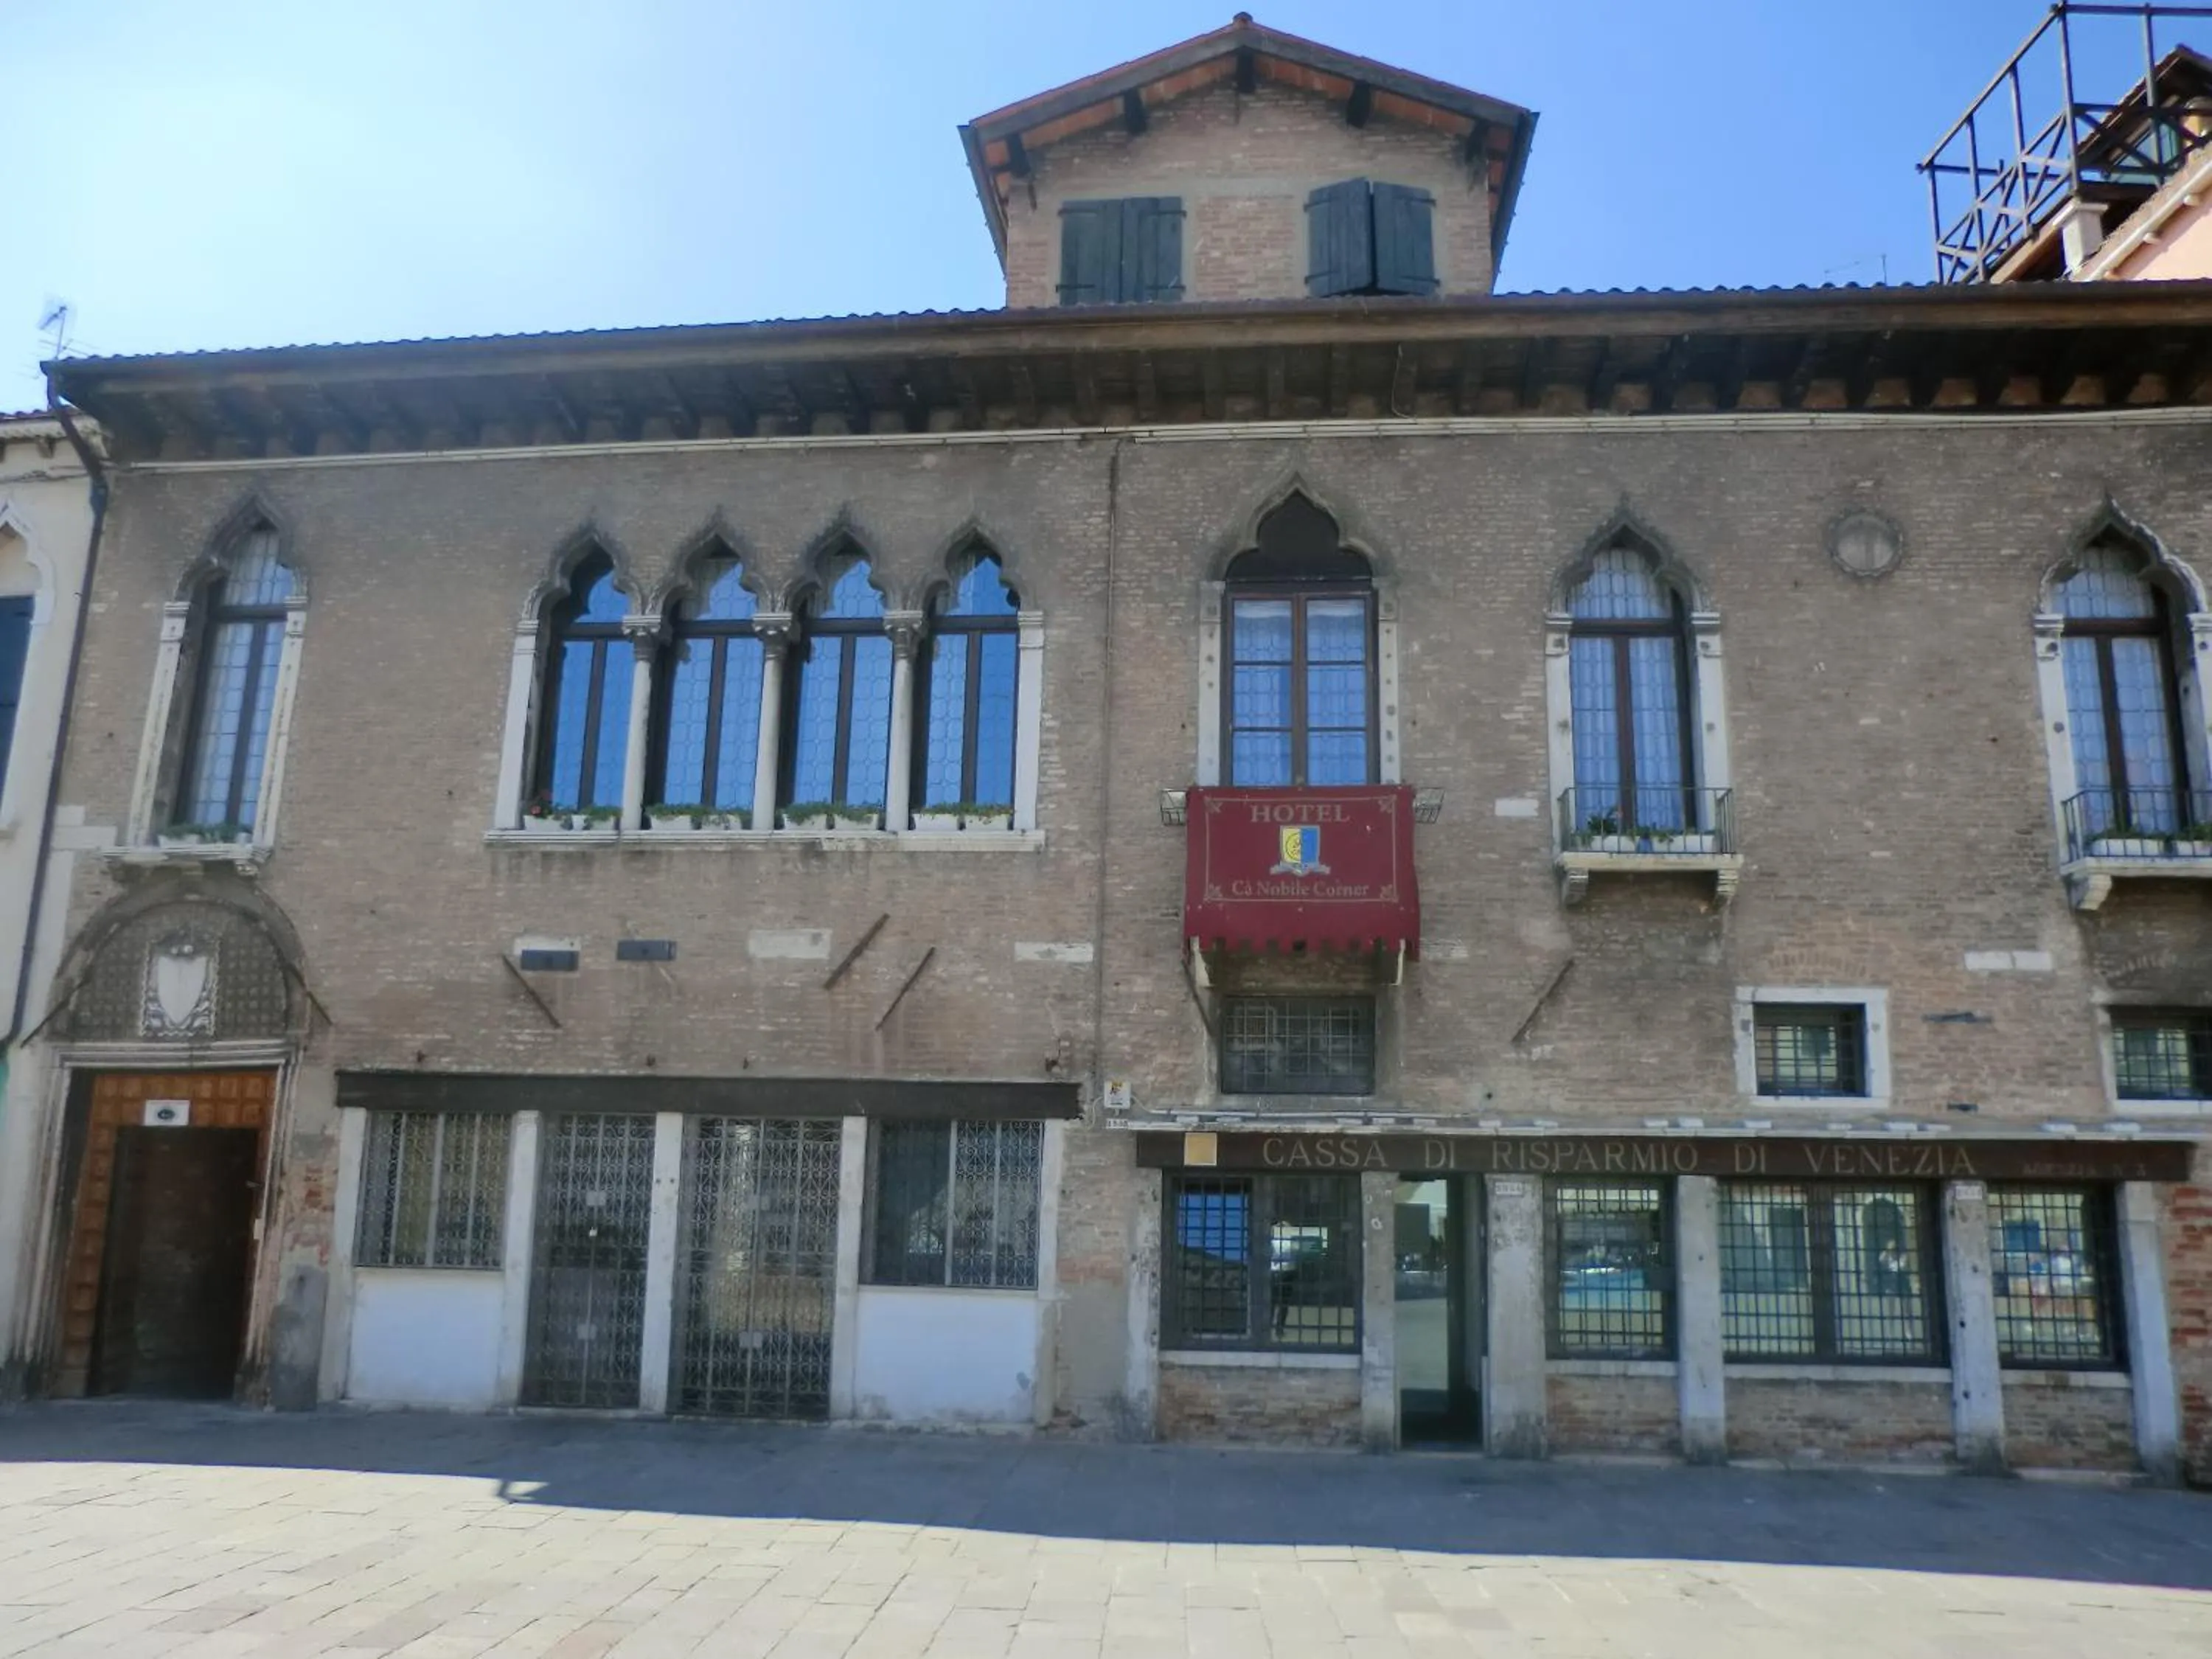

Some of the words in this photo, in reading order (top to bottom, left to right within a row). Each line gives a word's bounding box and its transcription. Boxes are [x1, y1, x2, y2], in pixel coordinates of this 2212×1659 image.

[1250, 804, 1350, 823] HOTEL
[1257, 880, 1310, 896] Nobile
[1314, 881, 1369, 897] Corner
[1263, 1139, 1388, 1167] CASSA
[1425, 1141, 1455, 1169] DI
[1493, 1141, 1697, 1172] RISPARMIO
[1735, 1146, 1767, 1173] DI
[1805, 1144, 1977, 1175] VENEZIA
